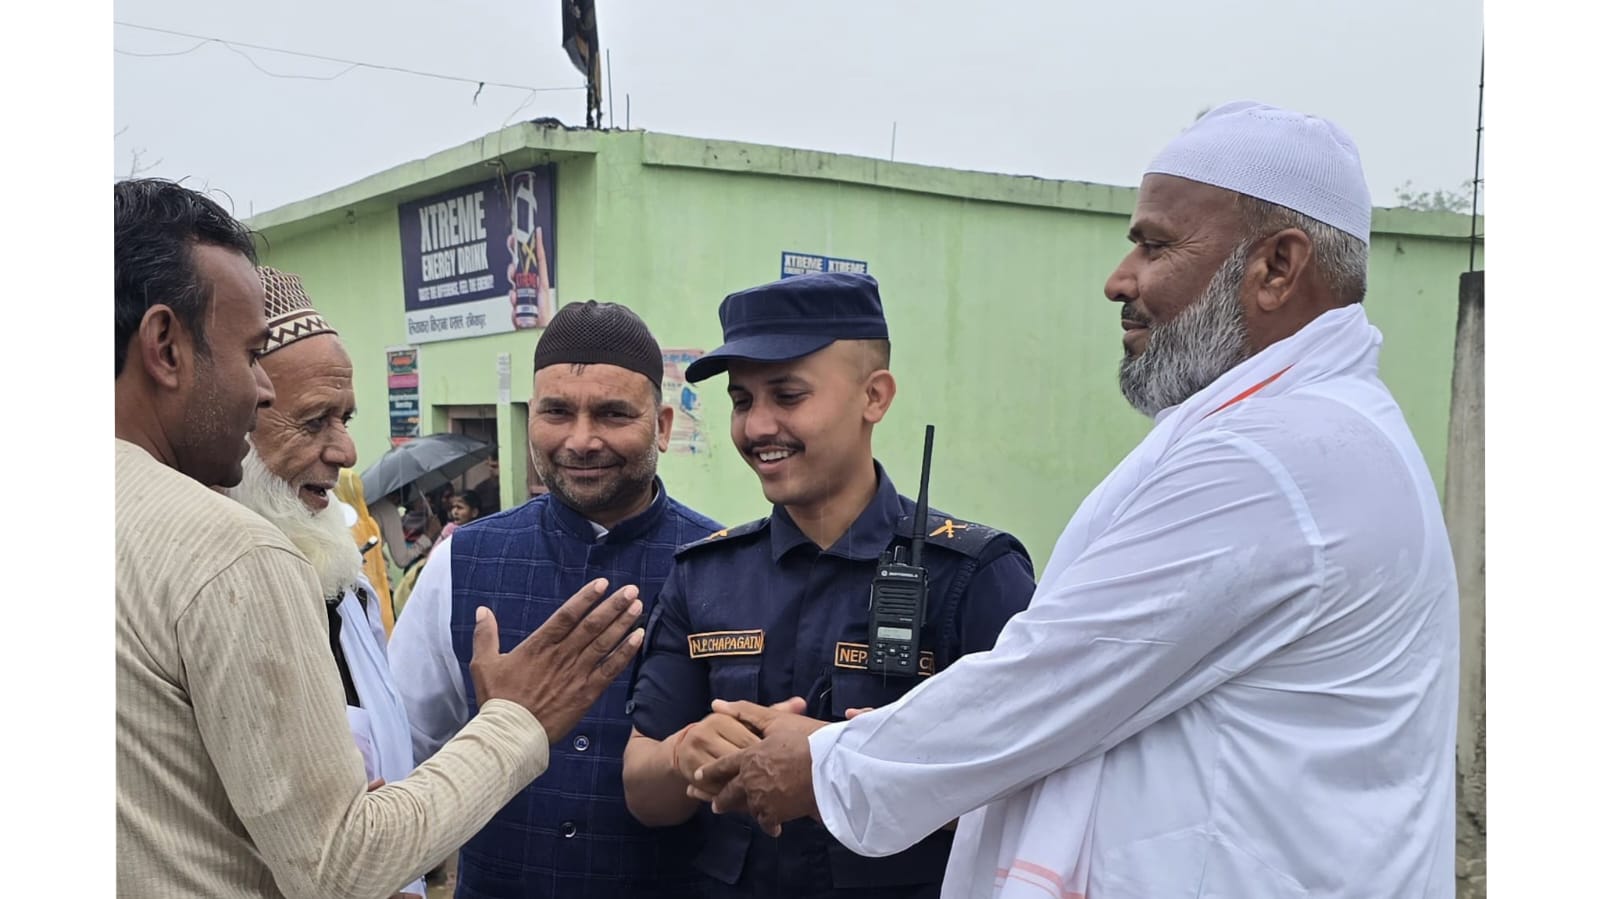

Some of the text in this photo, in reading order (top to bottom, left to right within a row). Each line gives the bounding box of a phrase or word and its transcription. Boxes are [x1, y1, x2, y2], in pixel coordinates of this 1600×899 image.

[419, 191, 487, 253] XTREME
[421, 241, 489, 282] ENERGY DRINK
[784, 255, 824, 271] XTREME
[828, 260, 866, 274] XTREME
